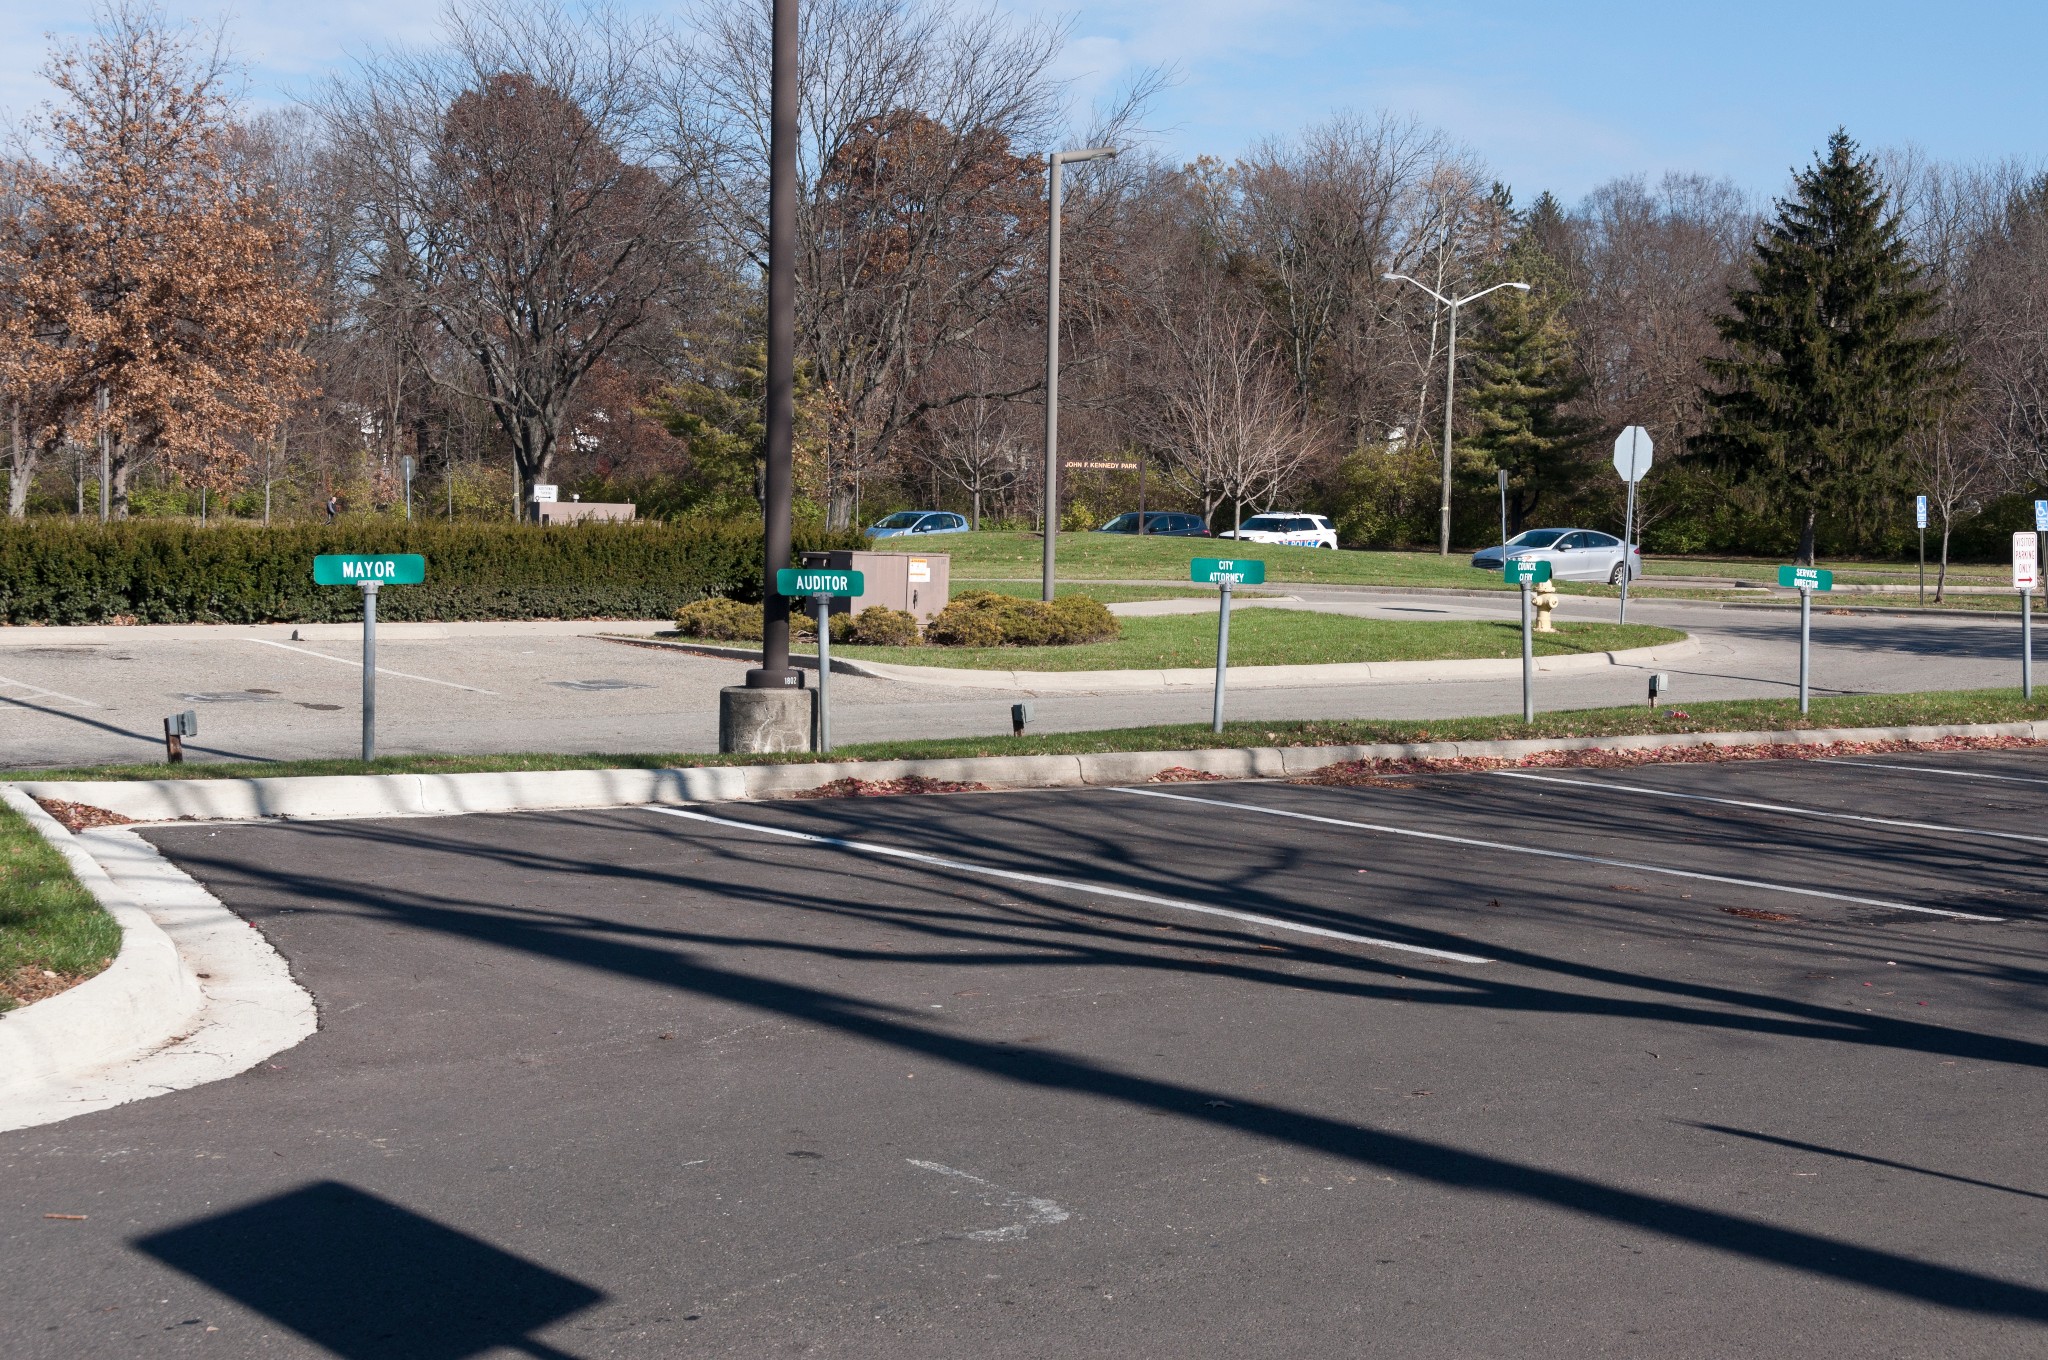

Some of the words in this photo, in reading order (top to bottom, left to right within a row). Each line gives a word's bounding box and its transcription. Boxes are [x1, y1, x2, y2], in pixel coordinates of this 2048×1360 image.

[1291, 540, 1316, 548] POLICE
[2016, 537, 2034, 547] VISITOR
[2016, 551, 2035, 560] PARKING
[342, 561, 395, 578] MAYOR
[1218, 560, 1234, 570] CITY
[1517, 562, 1537, 571] COUNCIL
[2019, 564, 2031, 573] ONLY
[1209, 572, 1245, 583] ATTORNEY
[1796, 568, 1817, 578] SERVICE
[796, 575, 848, 591] AUDITOR
[1793, 578, 1819, 589] DIRECTOR
[784, 676, 797, 685] 1802
